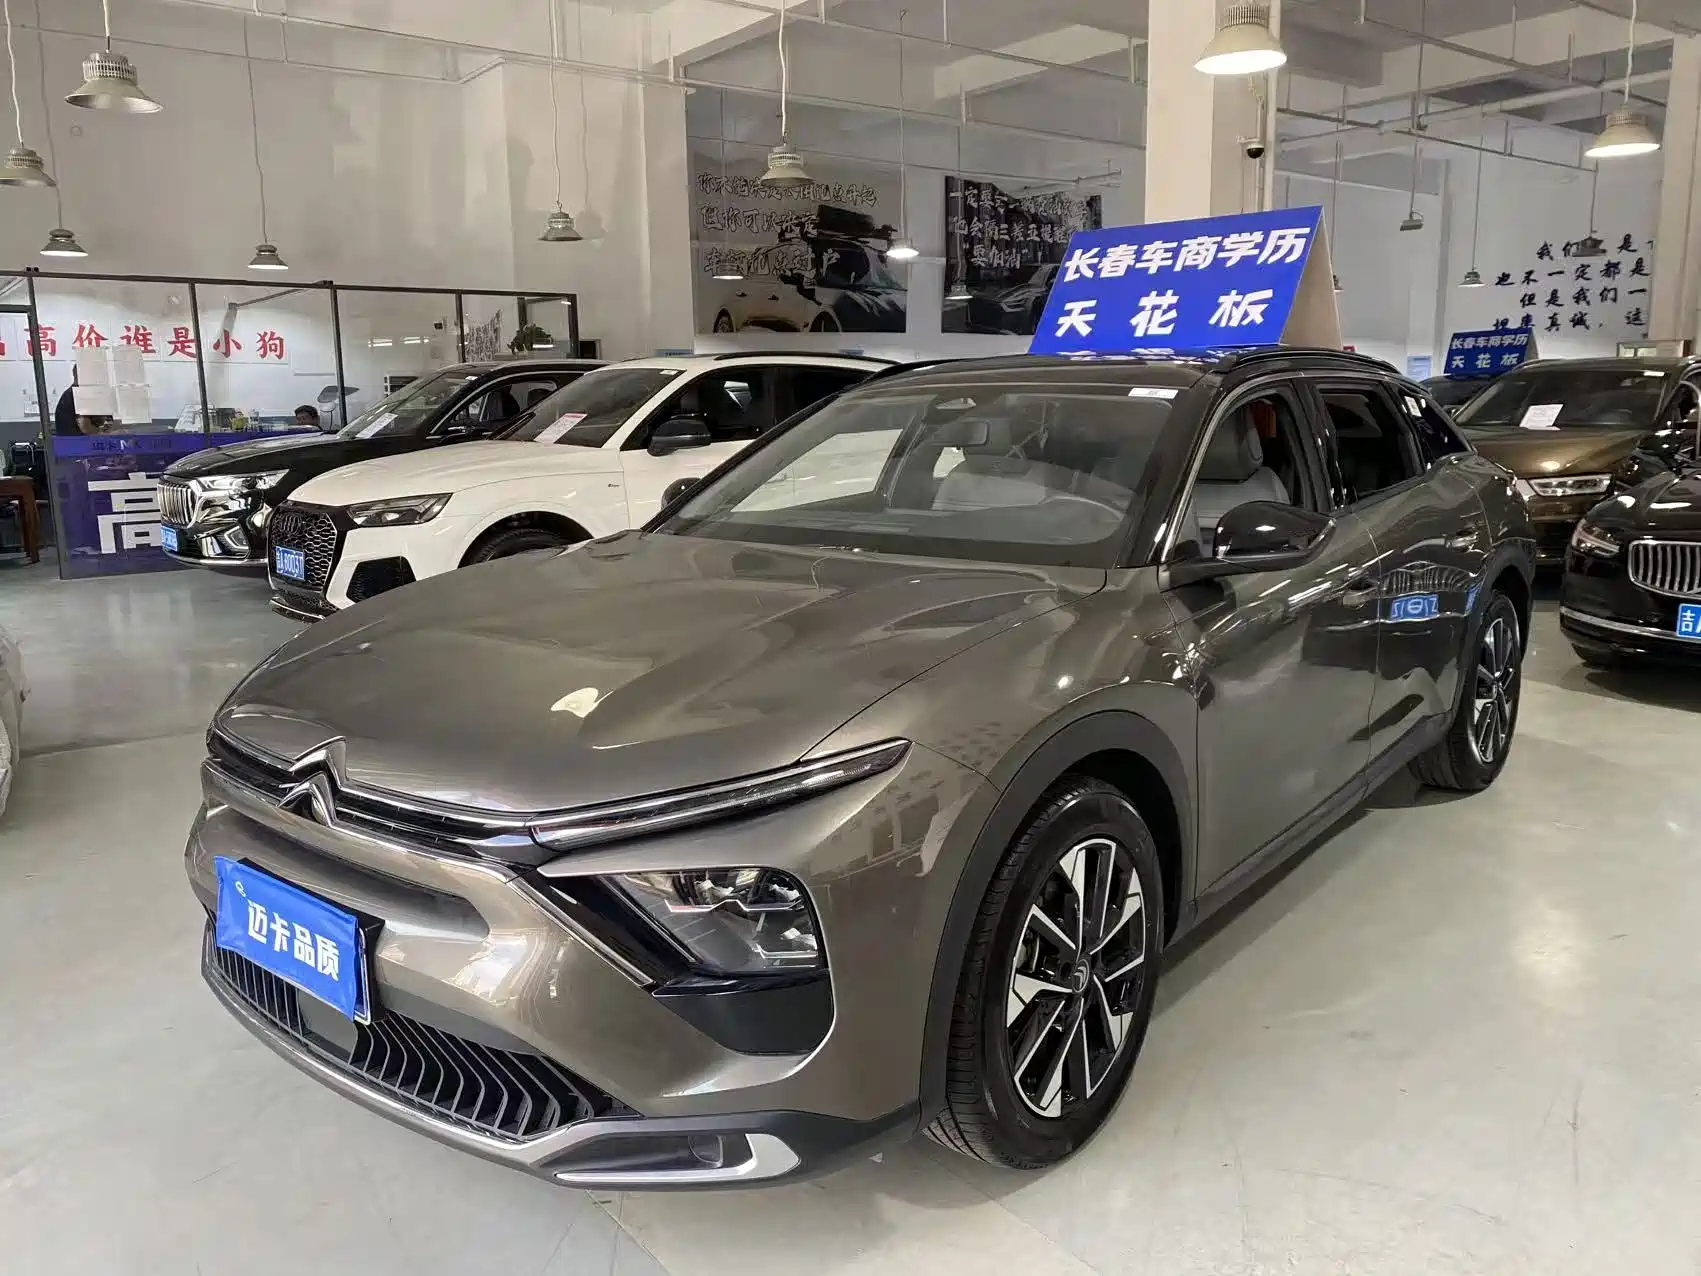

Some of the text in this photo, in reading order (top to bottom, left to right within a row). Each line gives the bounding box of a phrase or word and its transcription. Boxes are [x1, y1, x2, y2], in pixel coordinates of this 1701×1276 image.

[953, 215, 1086, 244] 他会隔三差五提醒
[1063, 227, 1310, 282] 长春车商学历
[1495, 257, 1650, 286] 也不一定都是
[1055, 288, 1273, 337] 天花板
[1520, 287, 1647, 309] 但是我们一
[0, 323, 286, 361] 高价谁是小狗
[1451, 333, 1529, 349] 长春车商学历
[1451, 352, 1520, 368] 天花板
[1681, 609, 1701, 634] 吉
[247, 900, 340, 982] 迈卡品质
